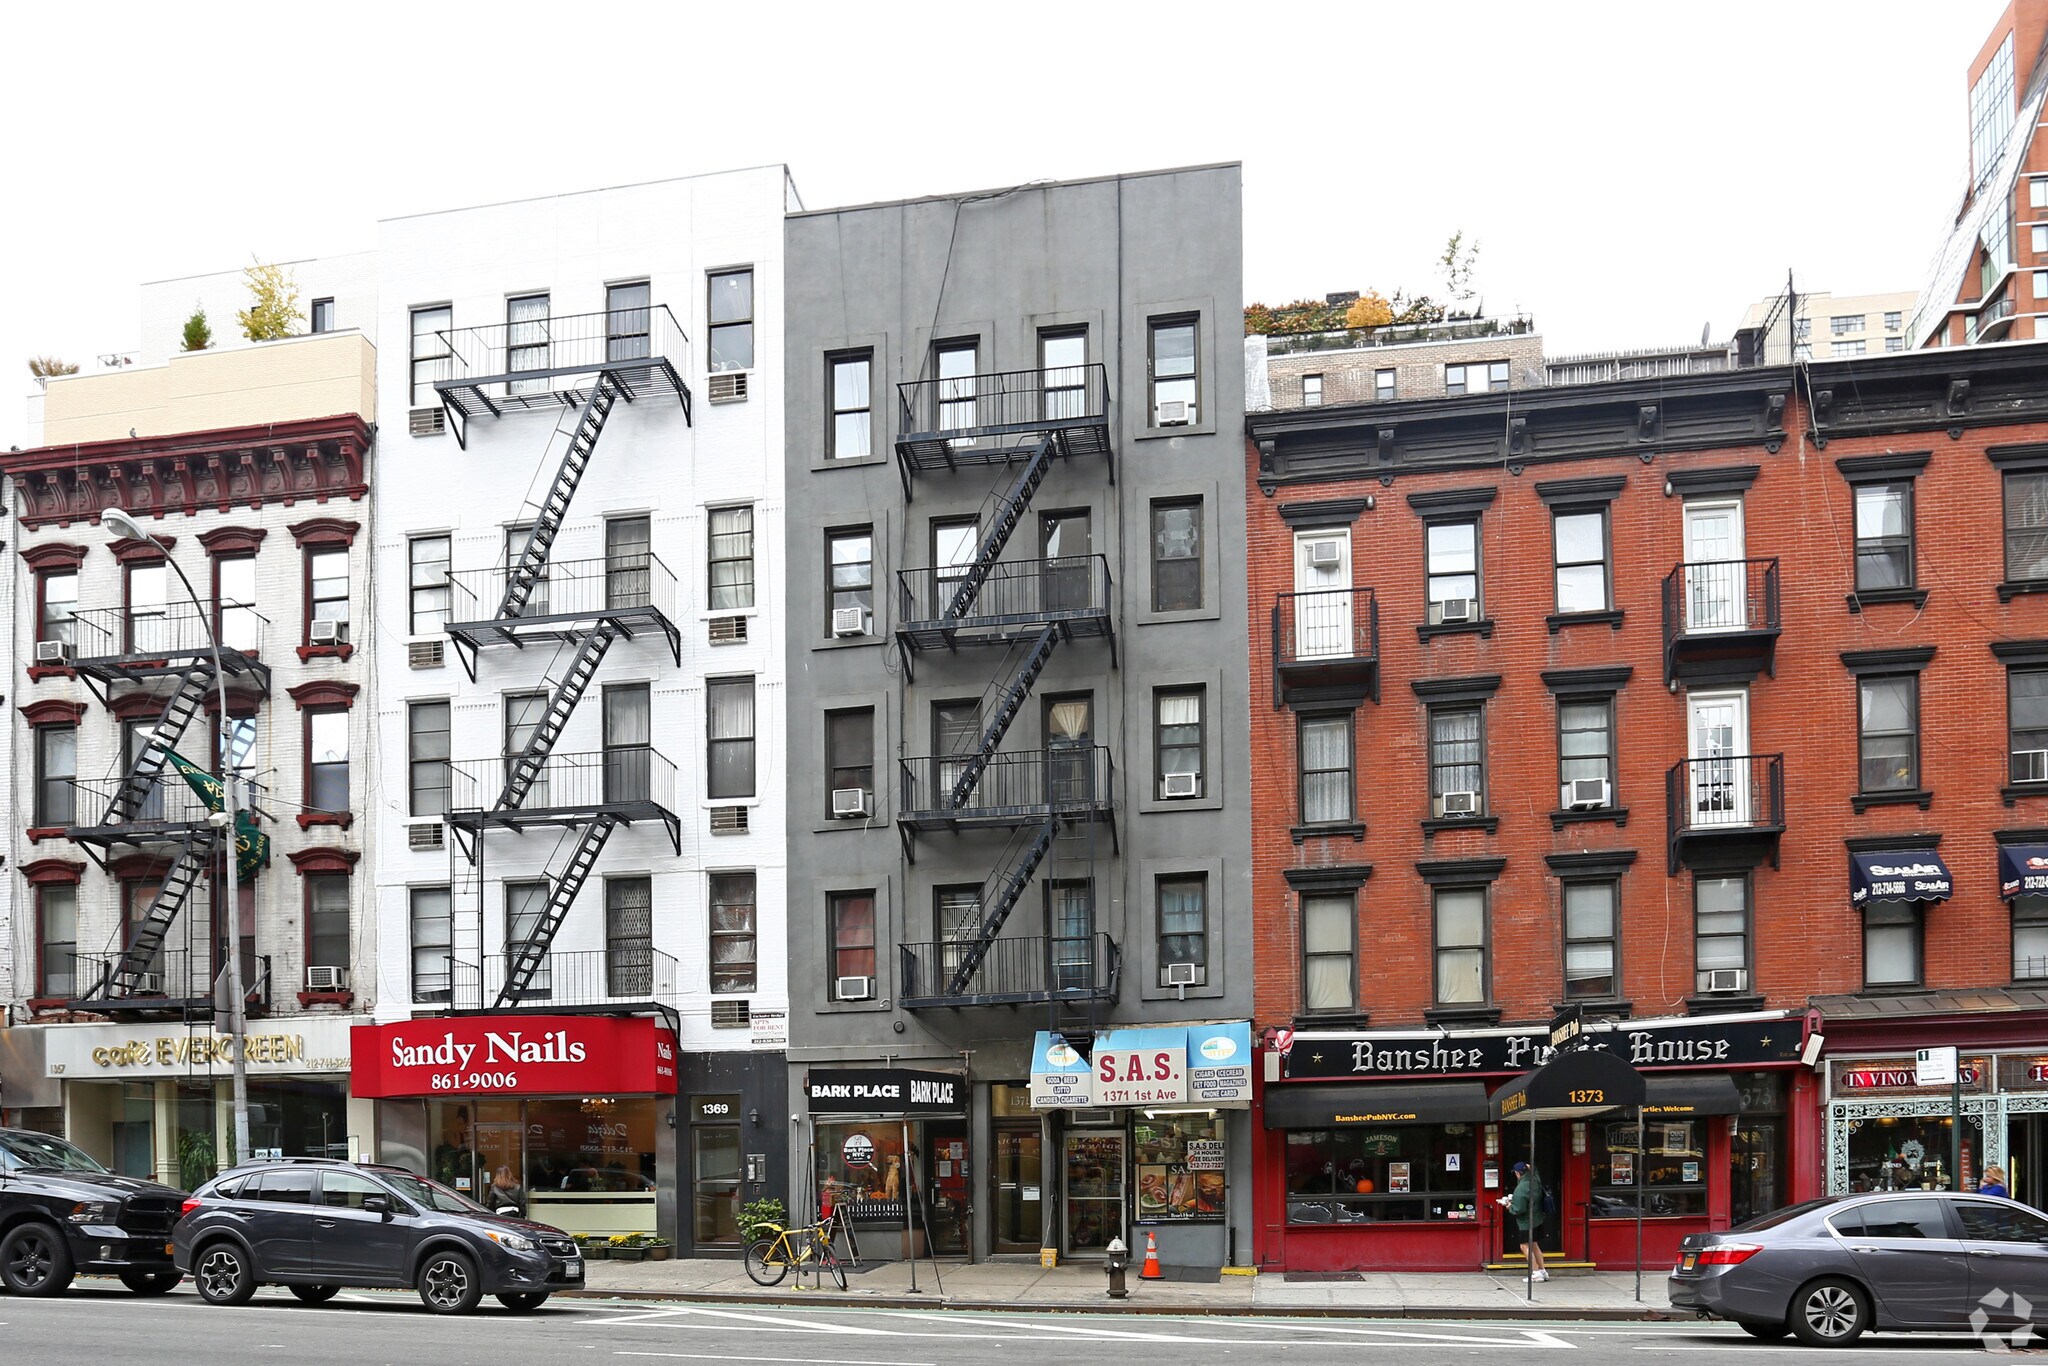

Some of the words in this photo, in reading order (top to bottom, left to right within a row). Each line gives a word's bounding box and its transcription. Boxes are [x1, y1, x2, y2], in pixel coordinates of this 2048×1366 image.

[1551, 1021, 1570, 1047] BANSHEE
[92, 1039, 151, 1066] café
[155, 1034, 304, 1064] EVERGREEN
[392, 1033, 476, 1071] Sandy
[484, 1031, 586, 1063] Nails
[657, 1042, 672, 1060] Nails
[1351, 1038, 1484, 1074] Banshee
[1628, 1031, 1731, 1064] House
[1920, 1051, 1926, 1061] 1
[1099, 1052, 1179, 1083] S.A.S.
[1195, 1070, 1214, 1078] CIGARS
[431, 1071, 518, 1090] 861-9006
[1193, 1081, 1203, 1089] PET
[1204, 1080, 1217, 1088] FOOD
[1219, 1079, 1246, 1087] MAGAZINES
[1848, 1073, 1866, 1087] IN
[1870, 1071, 1908, 1087] VINO
[812, 1085, 851, 1098] BARK
[853, 1084, 900, 1098] PLACE
[910, 1080, 932, 1104] BARK
[932, 1082, 954, 1104] PLACE
[1103, 1090, 1129, 1102] 1371
[1134, 1090, 1152, 1101] 1st
[1156, 1088, 1177, 1100] Ave
[1203, 1090, 1220, 1098] PHONE
[1568, 1090, 1604, 1103] 1373
[1738, 1087, 1772, 1106] 373
[702, 1103, 729, 1114] 1369
[1641, 1105, 1662, 1113] arties
[1335, 1113, 1416, 1122] BansheePubNYC.com
[1189, 1142, 1207, 1150] S.A.S
[1208, 1142, 1224, 1150] DELI
[1365, 1134, 1399, 1144] JAMESON
[1448, 1156, 1458, 1166] A
